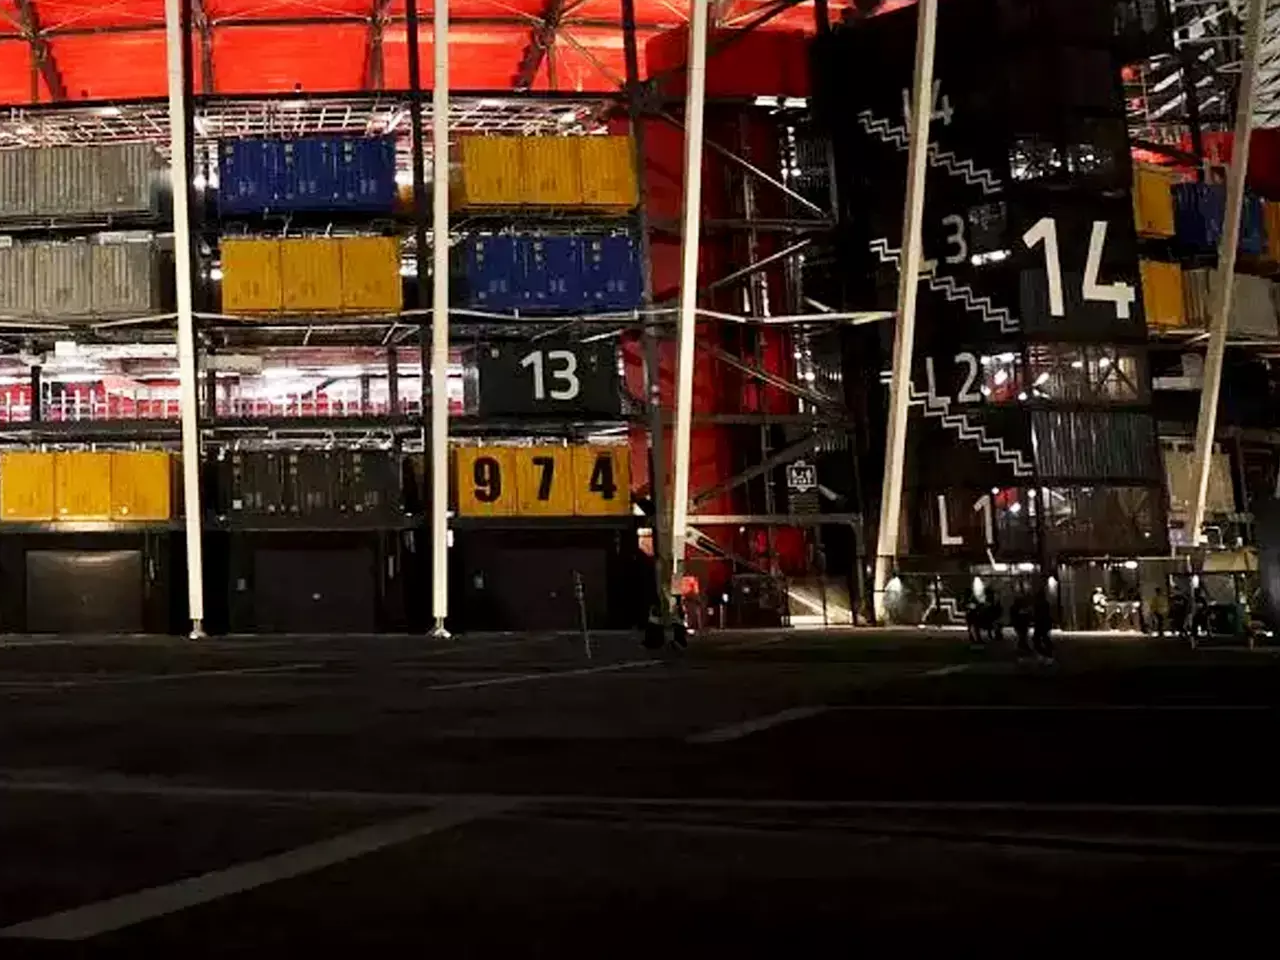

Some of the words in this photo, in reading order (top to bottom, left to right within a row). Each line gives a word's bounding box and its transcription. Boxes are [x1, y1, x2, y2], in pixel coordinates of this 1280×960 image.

[1022, 217, 1135, 319] 14
[521, 349, 580, 401] 13
[925, 352, 982, 408] L2
[937, 494, 994, 545] L1
